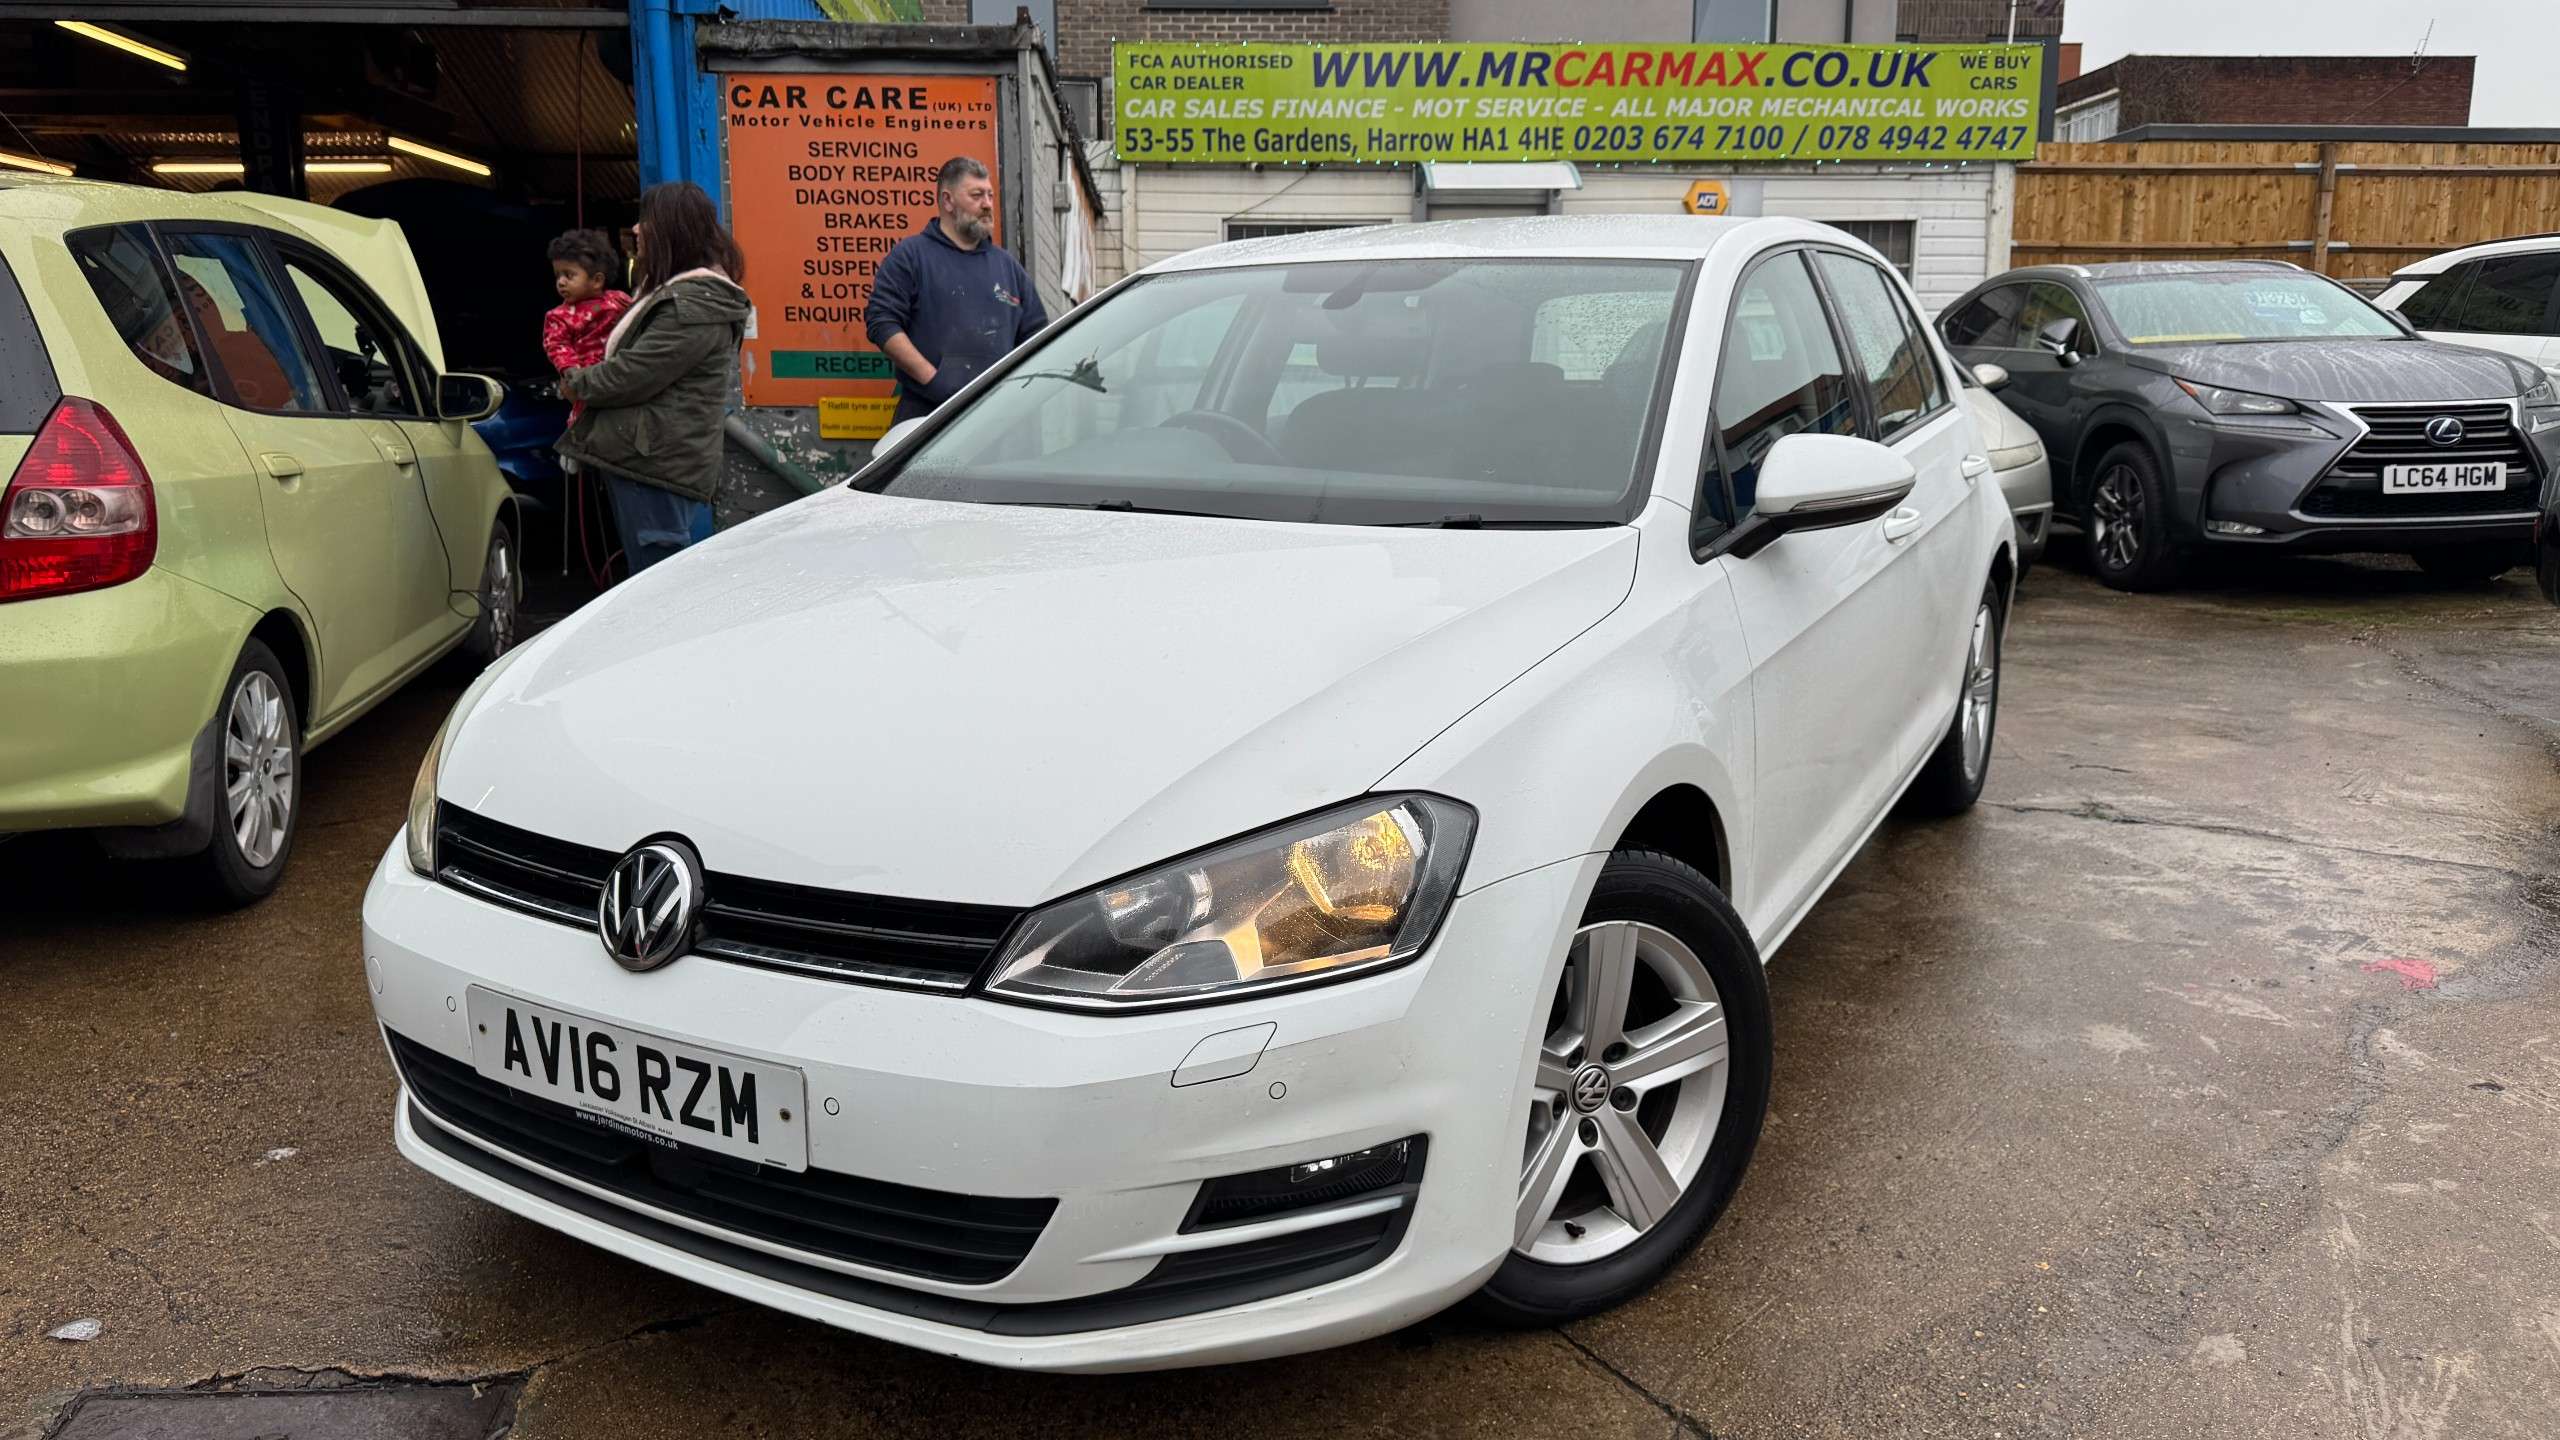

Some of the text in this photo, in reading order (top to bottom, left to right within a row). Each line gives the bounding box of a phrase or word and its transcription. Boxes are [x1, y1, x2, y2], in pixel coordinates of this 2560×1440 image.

[1130, 54, 1293, 69] FCA AUTHORISED
[1312, 51, 1937, 88] WWW.MRCARMAX.CO.UK
[1960, 55, 2031, 70] WE BUY
[1130, 76, 1244, 90] CAR DEALER
[1970, 76, 2018, 91] CARS
[731, 84, 992, 113] CAR CARE (UK) LTD
[1124, 98, 1176, 119] CAR
[1183, 98, 1265, 119] SALES
[1271, 98, 1388, 118] FINANCE
[1412, 98, 1470, 118] MOT
[1475, 97, 1587, 118] SERVICE
[1610, 97, 1657, 118] ALL
[1665, 97, 1753, 118] MAJOR
[1760, 97, 1926, 118] MECHANICAL
[1936, 97, 2029, 118] WORKS
[731, 114, 988, 132] Motor Vehicle Engineers
[1125, 127, 1194, 152] 53-55
[1202, 127, 1246, 152] The
[1254, 127, 1358, 156] Gardens,
[1368, 127, 1454, 152] Harrow
[1463, 127, 1509, 151] HA1
[1518, 126, 1564, 151] 4HE
[1573, 125, 1645, 151] 0203
[1653, 125, 1705, 150] 674
[1714, 125, 1784, 150] 7100
[1818, 125, 1870, 150] 078
[1878, 125, 1948, 150] 4942
[1956, 125, 2028, 150] 4747
[808, 141, 918, 159] SERVICING
[788, 165, 939, 183] BODY REPAIRS
[796, 188, 935, 206] DIAGNOSTICS
[824, 213, 909, 230] BRAKES
[801, 283, 873, 300] & LOTS
[2392, 465, 2497, 488] LC64 HGM
[504, 1007, 760, 1145] AV16 RZM
[575, 1110, 679, 1151] www.jardinemotors.co.uk
